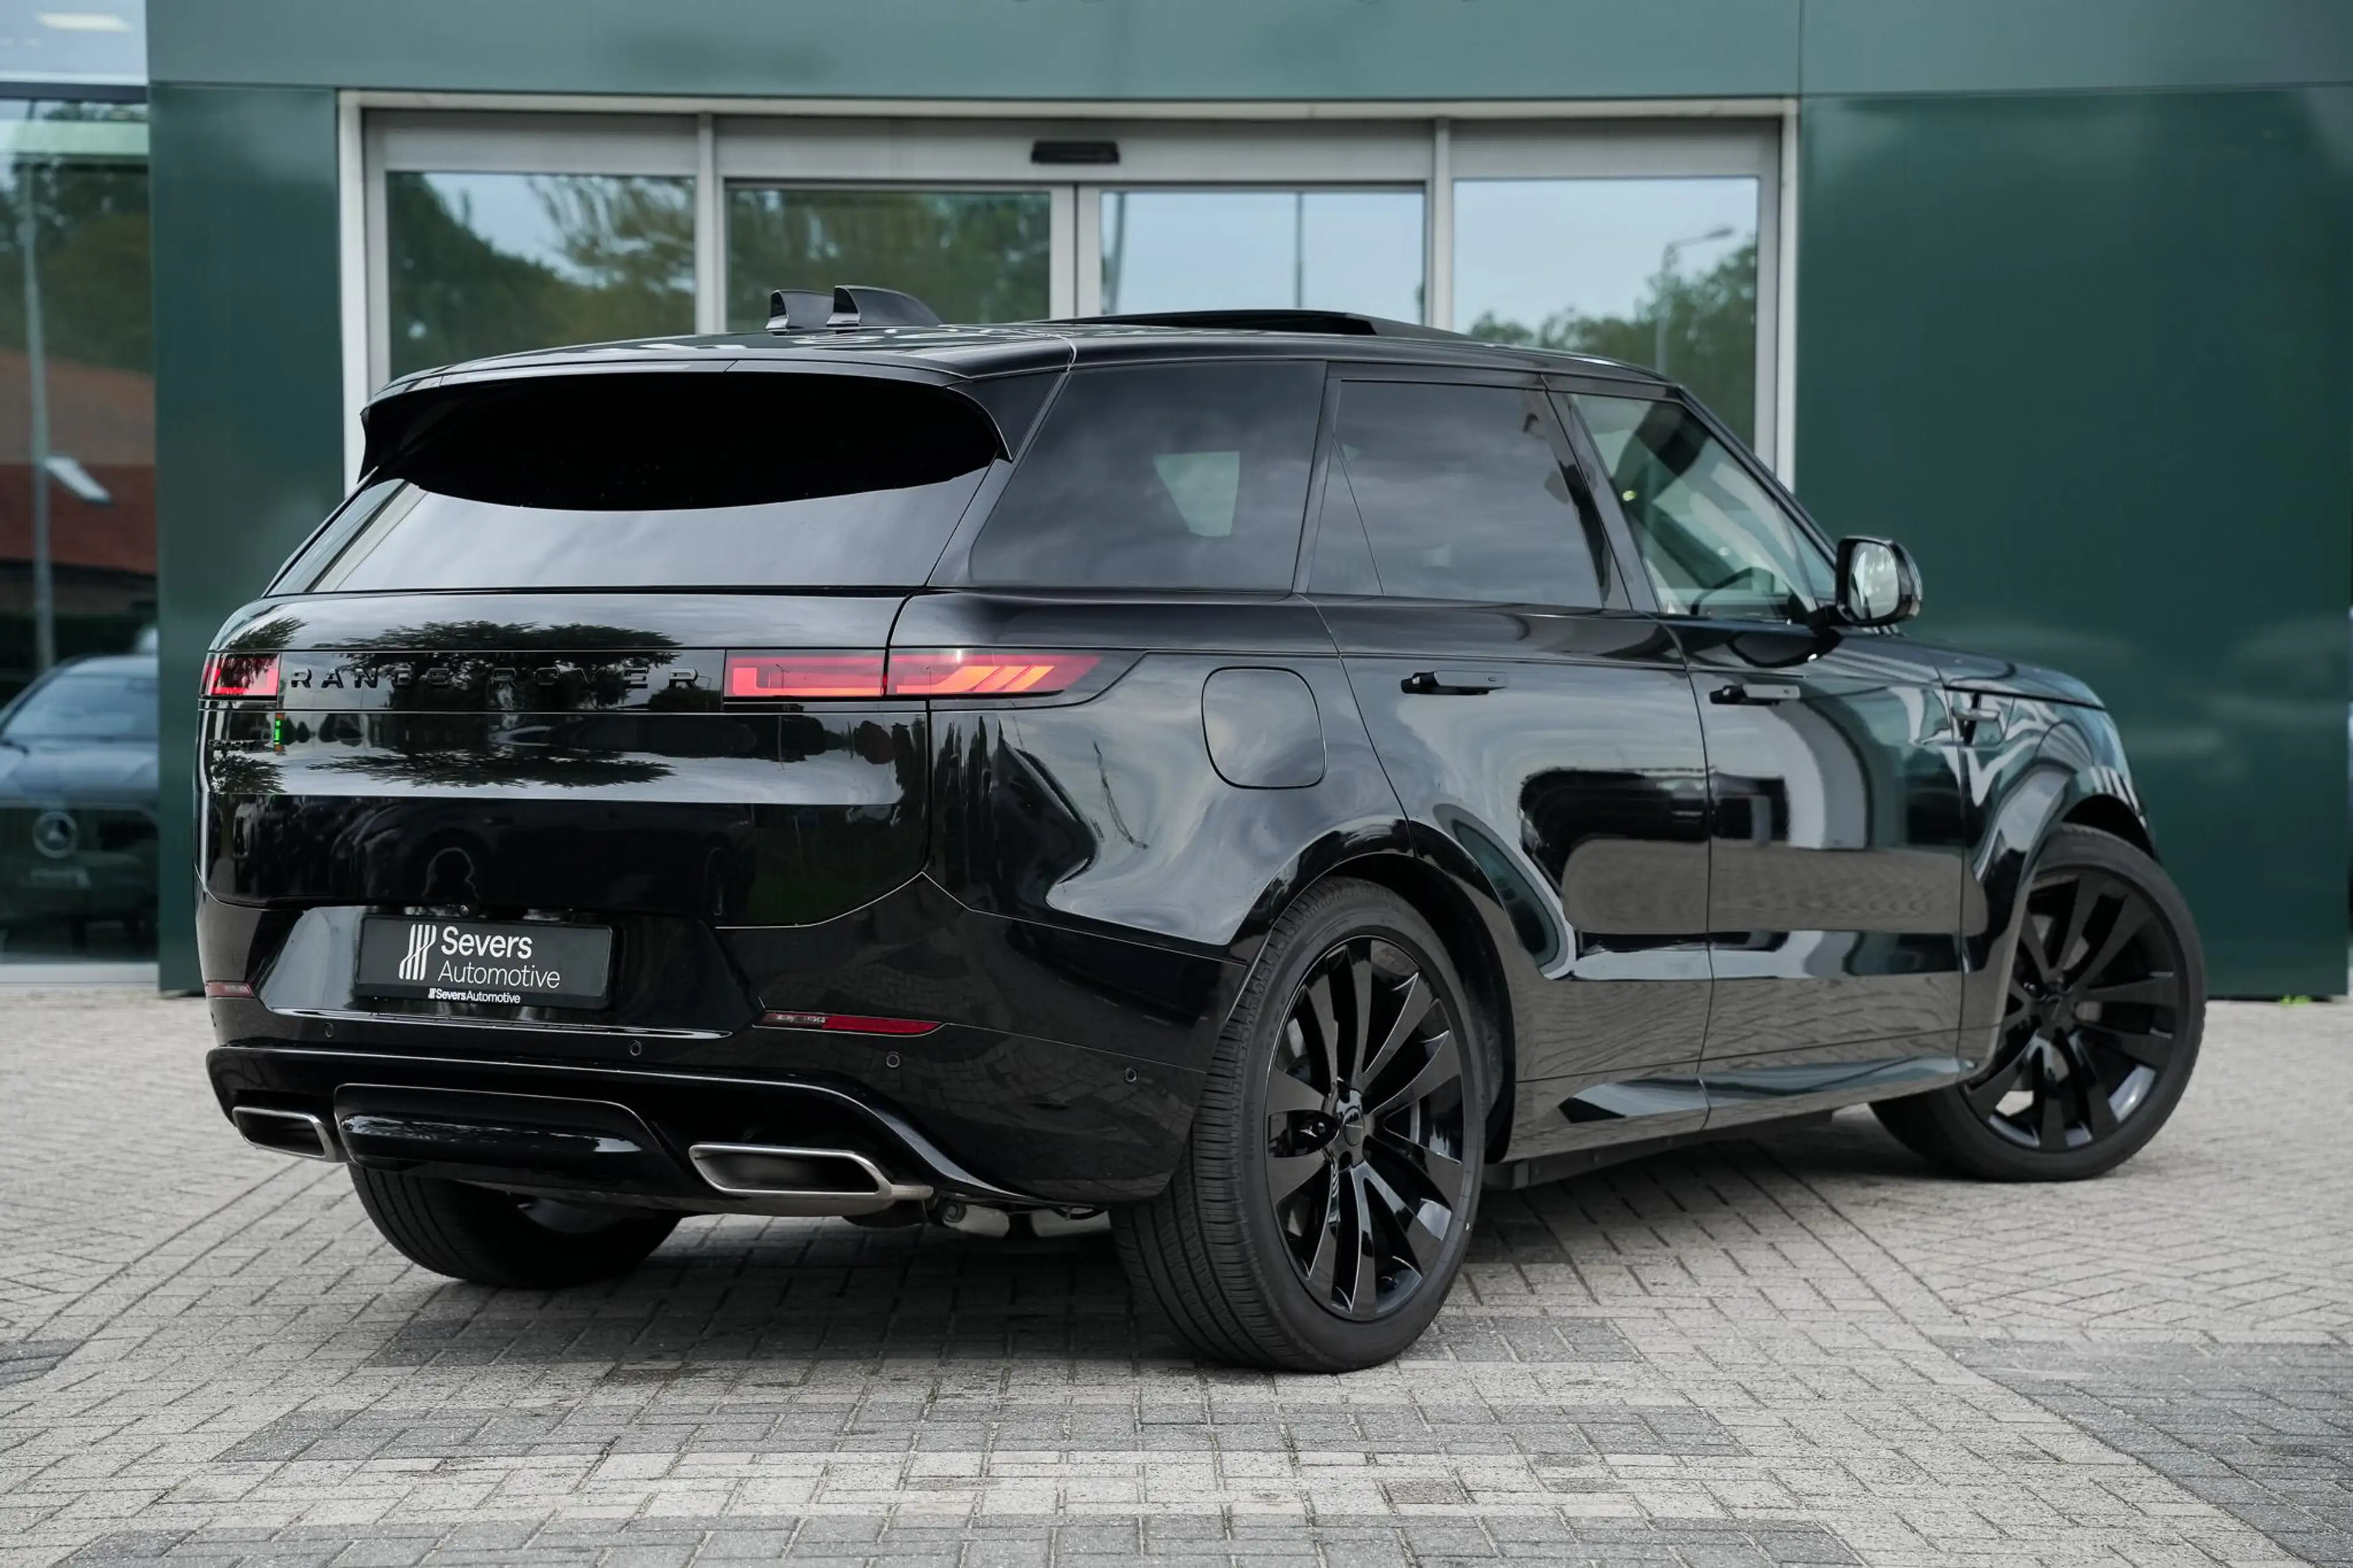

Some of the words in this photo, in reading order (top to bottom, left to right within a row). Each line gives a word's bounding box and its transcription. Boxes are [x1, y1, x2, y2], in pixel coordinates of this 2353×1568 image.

[290, 668, 450, 688] RANGE
[441, 926, 532, 959] Severs
[438, 960, 561, 989] Automotive
